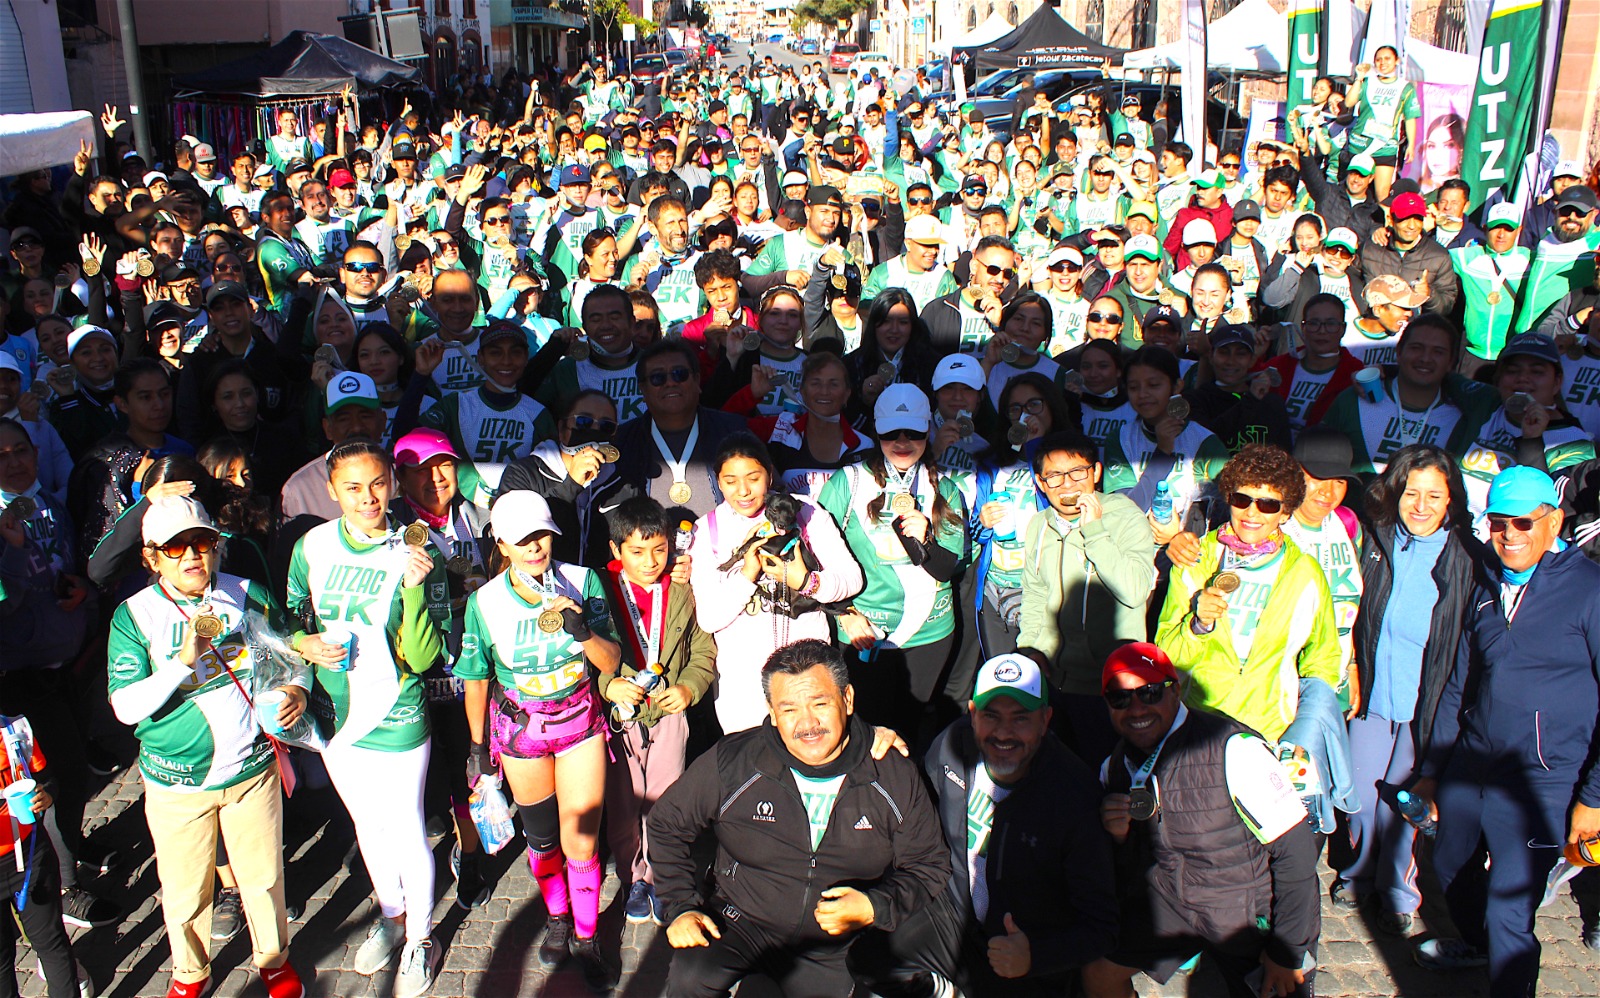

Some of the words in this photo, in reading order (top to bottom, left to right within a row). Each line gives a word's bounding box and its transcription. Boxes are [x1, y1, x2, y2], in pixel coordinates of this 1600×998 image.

[1371, 96, 1394, 106] 5K
[570, 222, 593, 235] UTZAC
[662, 269, 695, 286] UTZAC
[657, 286, 692, 304] 5K
[184, 325, 203, 338] ZAC
[479, 418, 525, 440] UTZAC
[474, 440, 524, 463] 5K
[325, 564, 387, 596] UTZAC
[318, 595, 380, 627] 5K
[513, 637, 575, 667] 5K
[525, 664, 578, 691] 415
[149, 754, 195, 773] RENAULT
